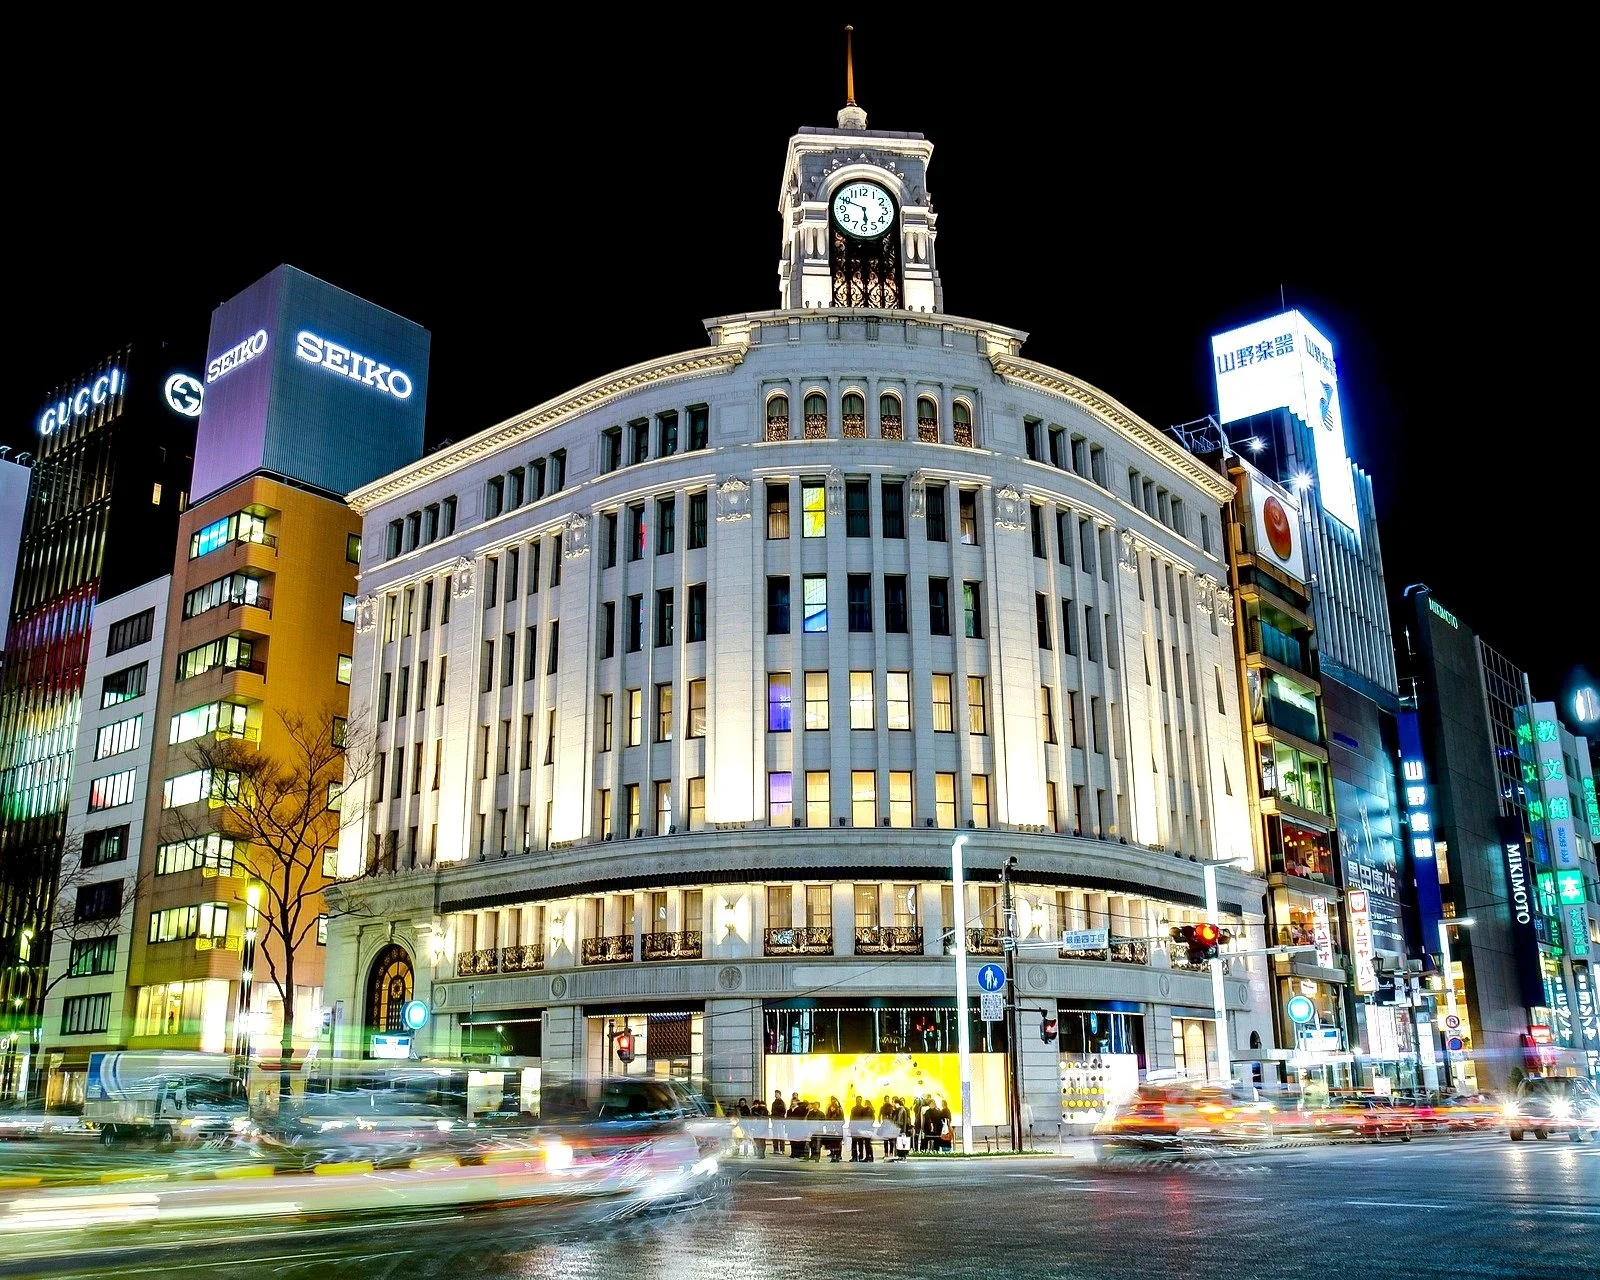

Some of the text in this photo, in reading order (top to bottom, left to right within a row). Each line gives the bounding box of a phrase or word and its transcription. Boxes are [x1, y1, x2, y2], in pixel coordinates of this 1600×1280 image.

[850, 190, 858, 199] 11
[859, 188, 868, 197] 12
[878, 197, 885, 206] 2
[839, 205, 847, 214] 9
[882, 207, 889, 216] 3
[843, 213, 850, 222] 8
[878, 215, 885, 224] 4
[851, 220, 859, 229] 7
[860, 223, 868, 232] 6
[870, 221, 878, 230] 5
[207, 328, 269, 384] SEIKO
[1216, 333, 1295, 375] 山野楽器
[295, 330, 413, 400] SEIKO
[39, 368, 122, 436] GUCCI
[1537, 720, 1569, 819] 教文館
[1507, 843, 1530, 924] MIKIMOTO
